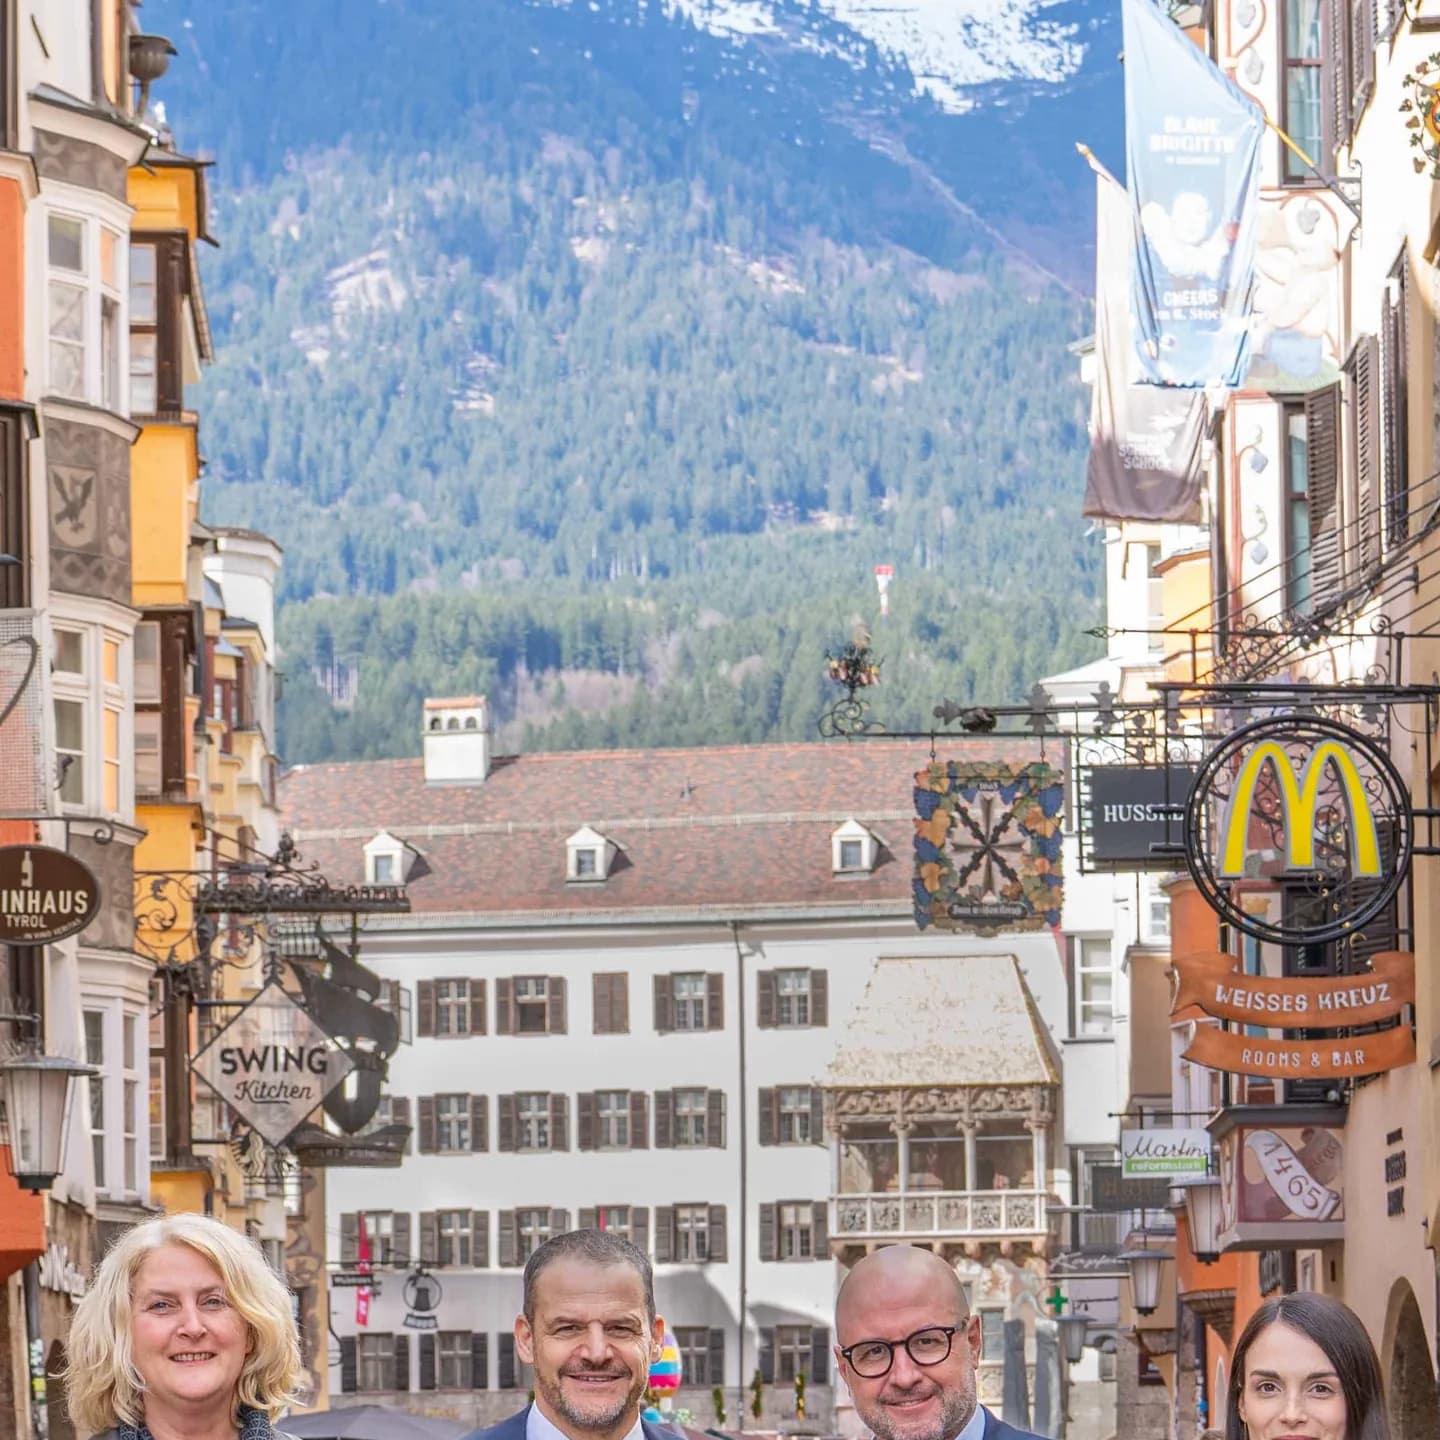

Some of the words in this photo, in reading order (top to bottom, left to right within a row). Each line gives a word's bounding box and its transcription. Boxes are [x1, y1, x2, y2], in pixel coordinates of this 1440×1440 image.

[1163, 289, 1218, 306] CHEERS
[5, 914, 48, 928] TYROL
[1215, 983, 1308, 1012] WEISSES
[1318, 983, 1391, 1010] KREUZ
[220, 1045, 328, 1075] SWING
[1242, 1048, 1300, 1067] ROOMS
[1311, 1055, 1320, 1067] &
[1332, 1050, 1365, 1066] BAR
[234, 1080, 313, 1104] Kitchen
[1263, 1142, 1322, 1210] 1465
